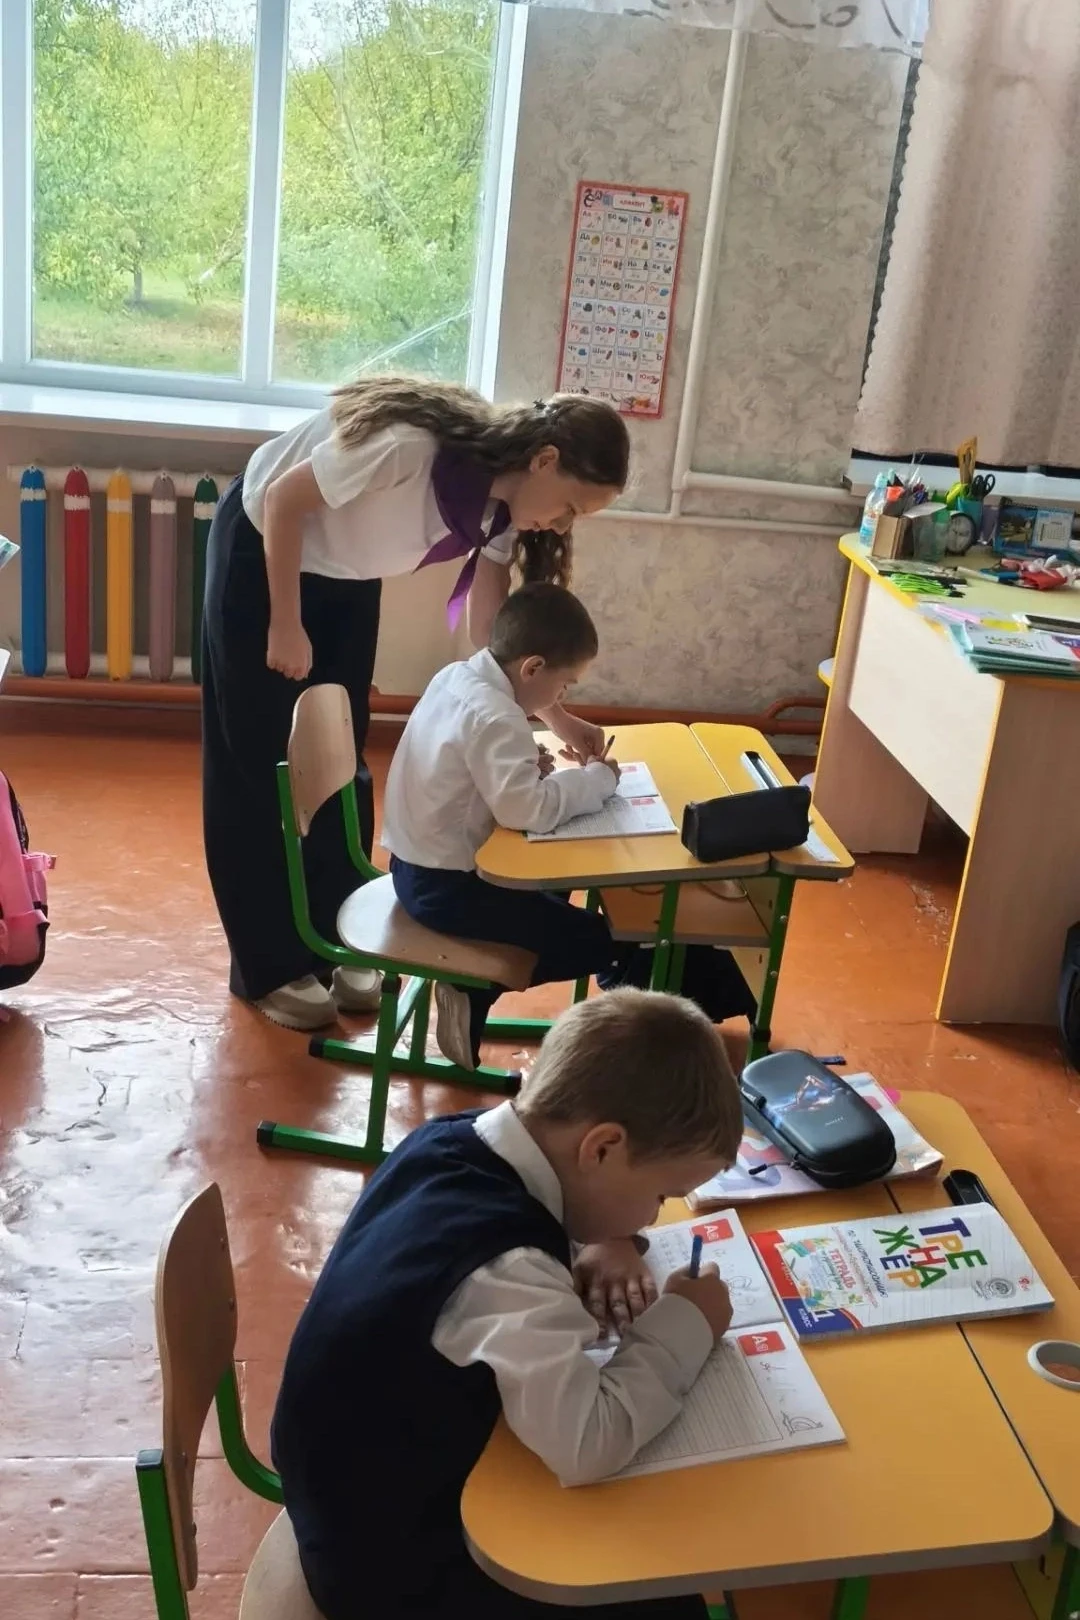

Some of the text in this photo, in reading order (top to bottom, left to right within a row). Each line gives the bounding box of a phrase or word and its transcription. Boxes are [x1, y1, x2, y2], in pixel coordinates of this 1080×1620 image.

[918, 1217, 988, 1270] ТРЕ
[828, 1248, 856, 1288] ТЕТРАДЬ
[908, 1246, 947, 1289] НА
[798, 1308, 812, 1329] класс
[810, 1308, 836, 1323] 1
